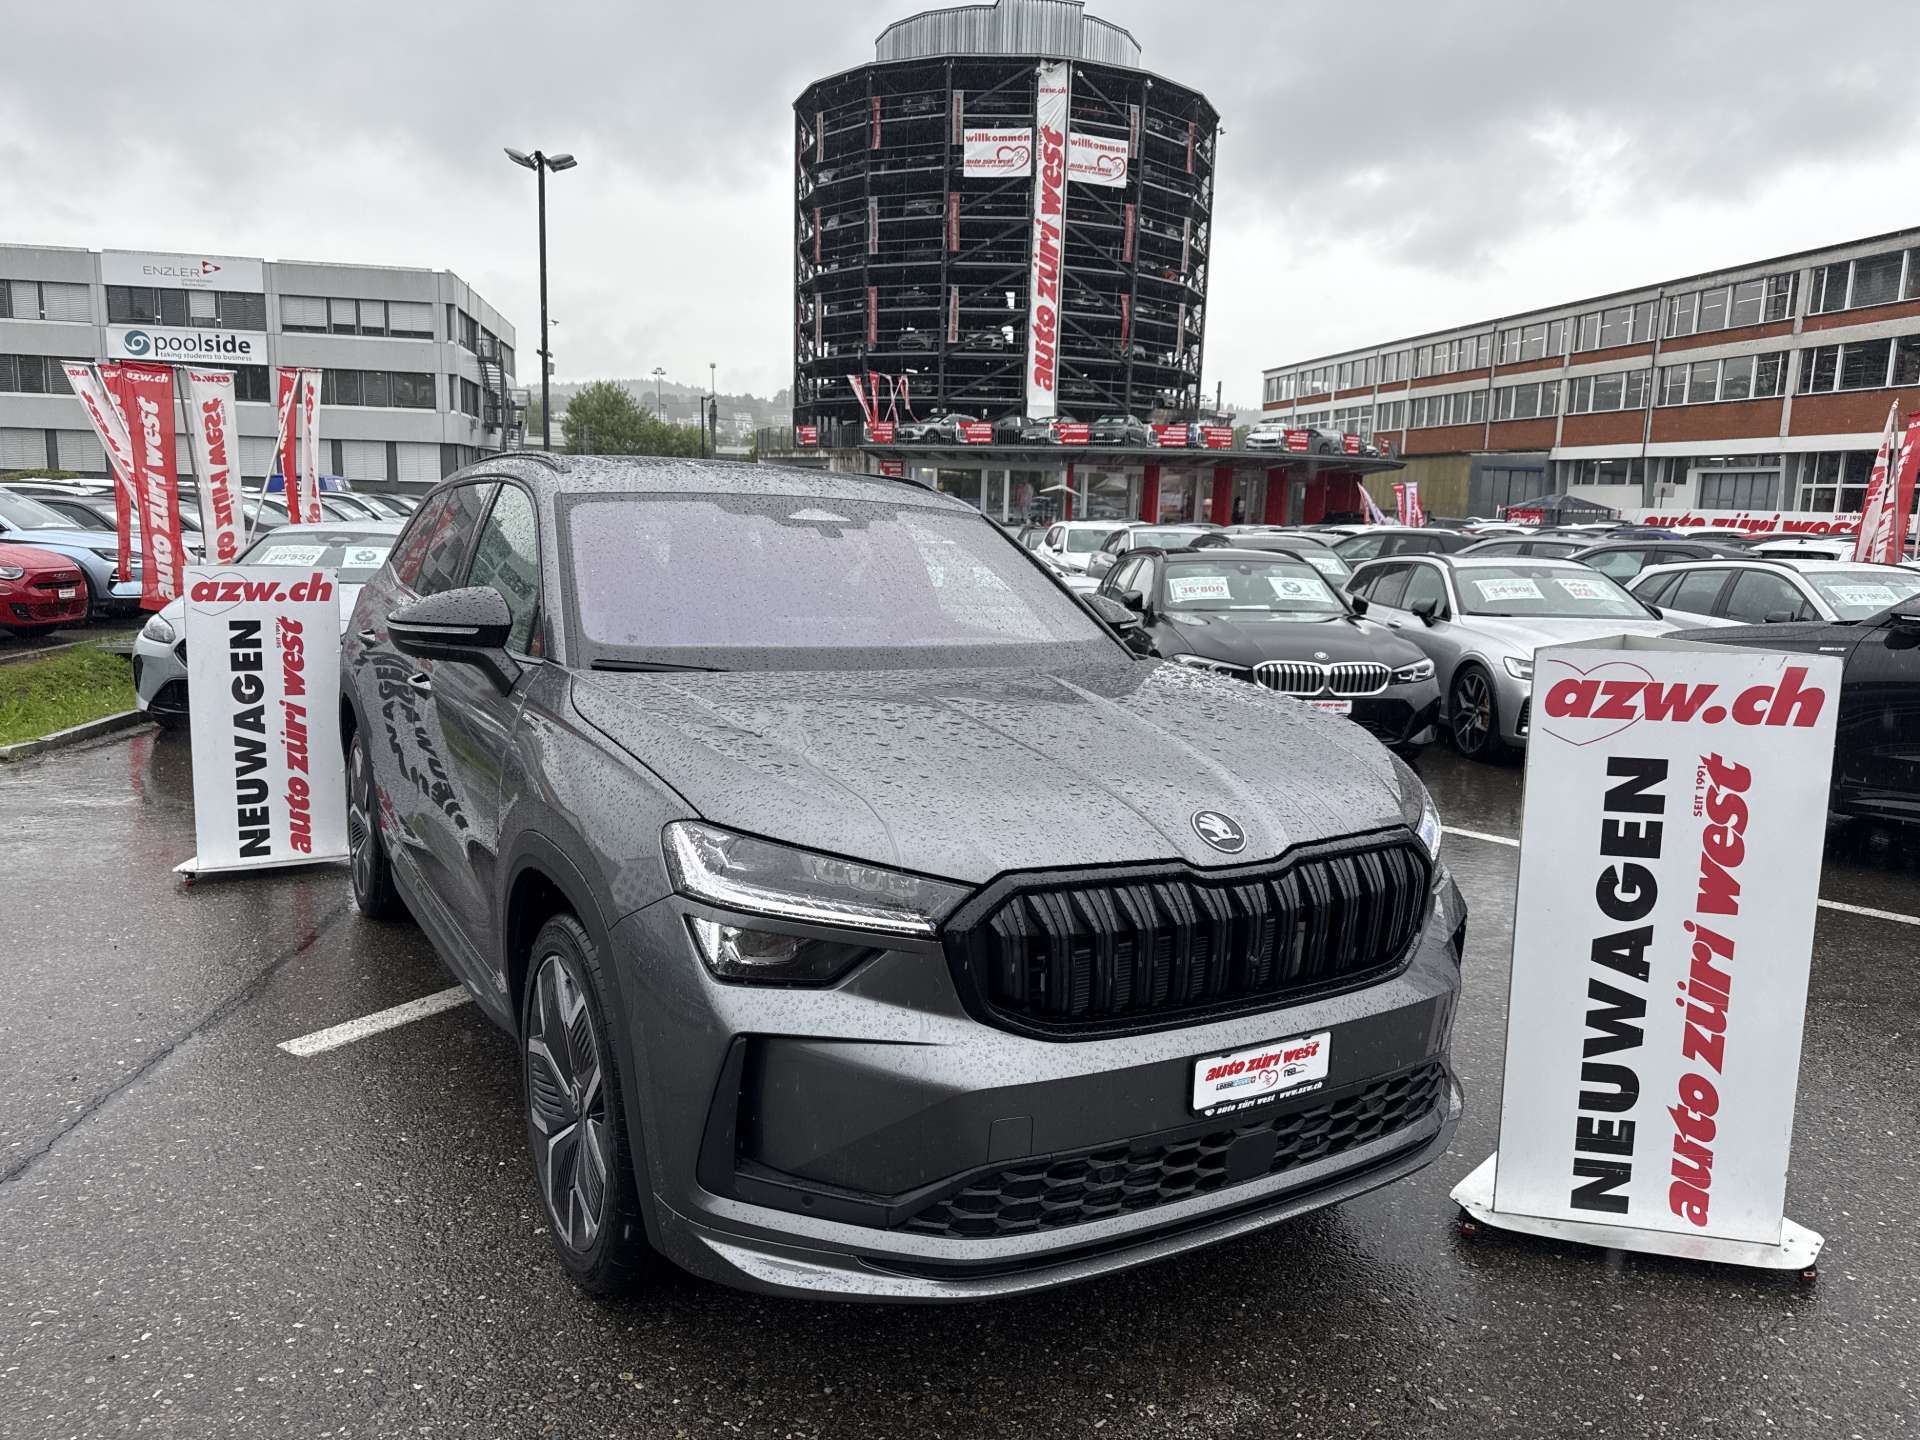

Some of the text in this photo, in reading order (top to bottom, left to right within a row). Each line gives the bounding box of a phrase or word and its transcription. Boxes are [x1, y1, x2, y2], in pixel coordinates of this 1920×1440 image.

[965, 132, 1030, 143] willkommen
[1070, 138, 1127, 153] willkommen
[142, 265, 201, 277] ENZLER
[1033, 125, 1064, 392] auto züri west
[153, 333, 251, 357] poolside
[160, 352, 182, 360] taking
[184, 352, 213, 360] students
[126, 371, 169, 383] azw.ch
[136, 396, 165, 467] west
[190, 572, 334, 603] azw.ch
[1544, 666, 1826, 728] azw.ch
[229, 619, 271, 859] NEUWAGEN
[276, 615, 312, 855] auto züri west
[1692, 764, 1707, 818] SEIT 1991
[1569, 756, 1669, 1215] NEUWAGEN
[1667, 752, 1752, 1228] auto züri west
[1205, 1042, 1320, 1081] auto züri west
[1216, 1105, 1236, 1115] auto
[1257, 1094, 1276, 1105] west
